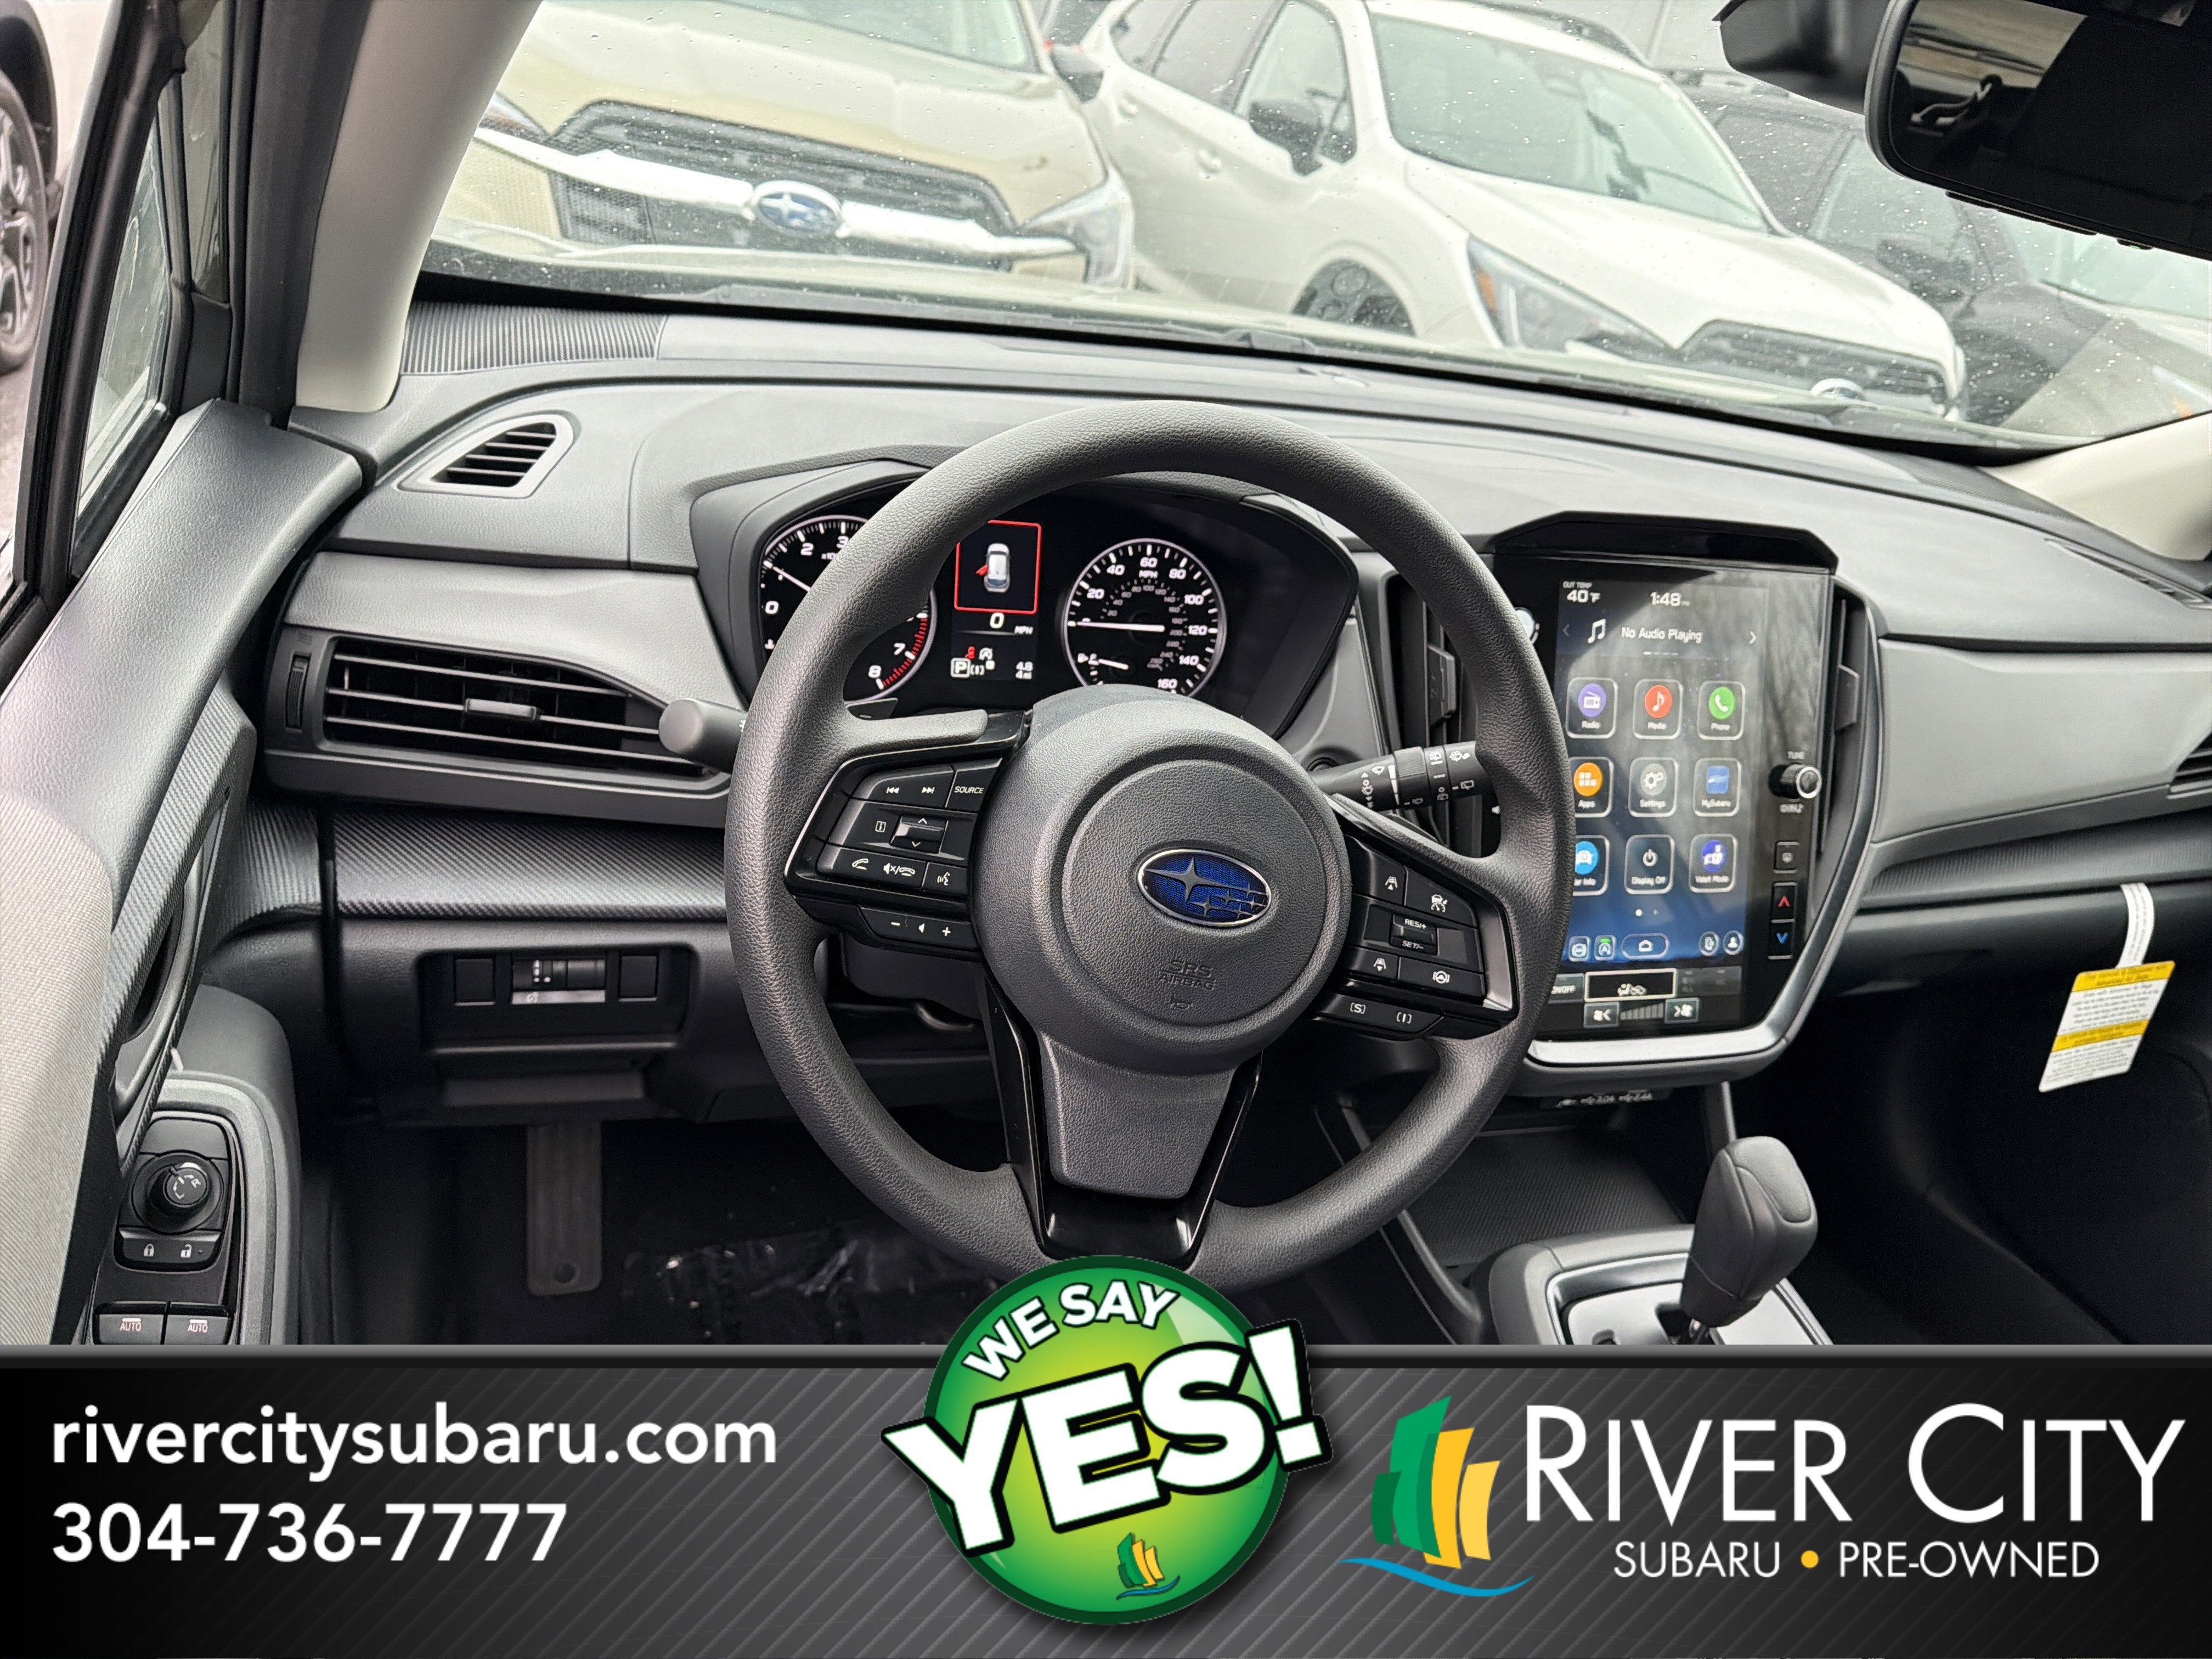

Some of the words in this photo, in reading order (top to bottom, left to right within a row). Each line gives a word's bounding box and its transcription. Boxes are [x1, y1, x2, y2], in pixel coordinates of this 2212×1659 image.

[836, 535, 849, 549] 3
[800, 543, 814, 556] 2
[1140, 557, 1158, 567] 60
[1107, 565, 1125, 575] 40
[1169, 569, 1186, 579] 80
[1086, 588, 1104, 599] 20
[1567, 590, 1588, 602] 40
[1651, 592, 1680, 606] 1:48
[1184, 594, 1204, 605] 100
[765, 601, 778, 614] 0
[990, 613, 1004, 628] 0
[1014, 626, 1032, 634] MPH
[1188, 625, 1207, 635] 120
[1622, 627, 1635, 638] No
[1639, 628, 1665, 639] Audio
[1668, 629, 1702, 643] Playing
[894, 642, 905, 655] 7
[1179, 655, 1199, 666] 140
[868, 665, 881, 678] 8
[1158, 679, 1177, 689] 160
[953, 786, 984, 794] SOURCE
[1160, 973, 1216, 991] AIRBAG
[119, 1322, 142, 1332] AUTO
[187, 1323, 208, 1333] AUTO
